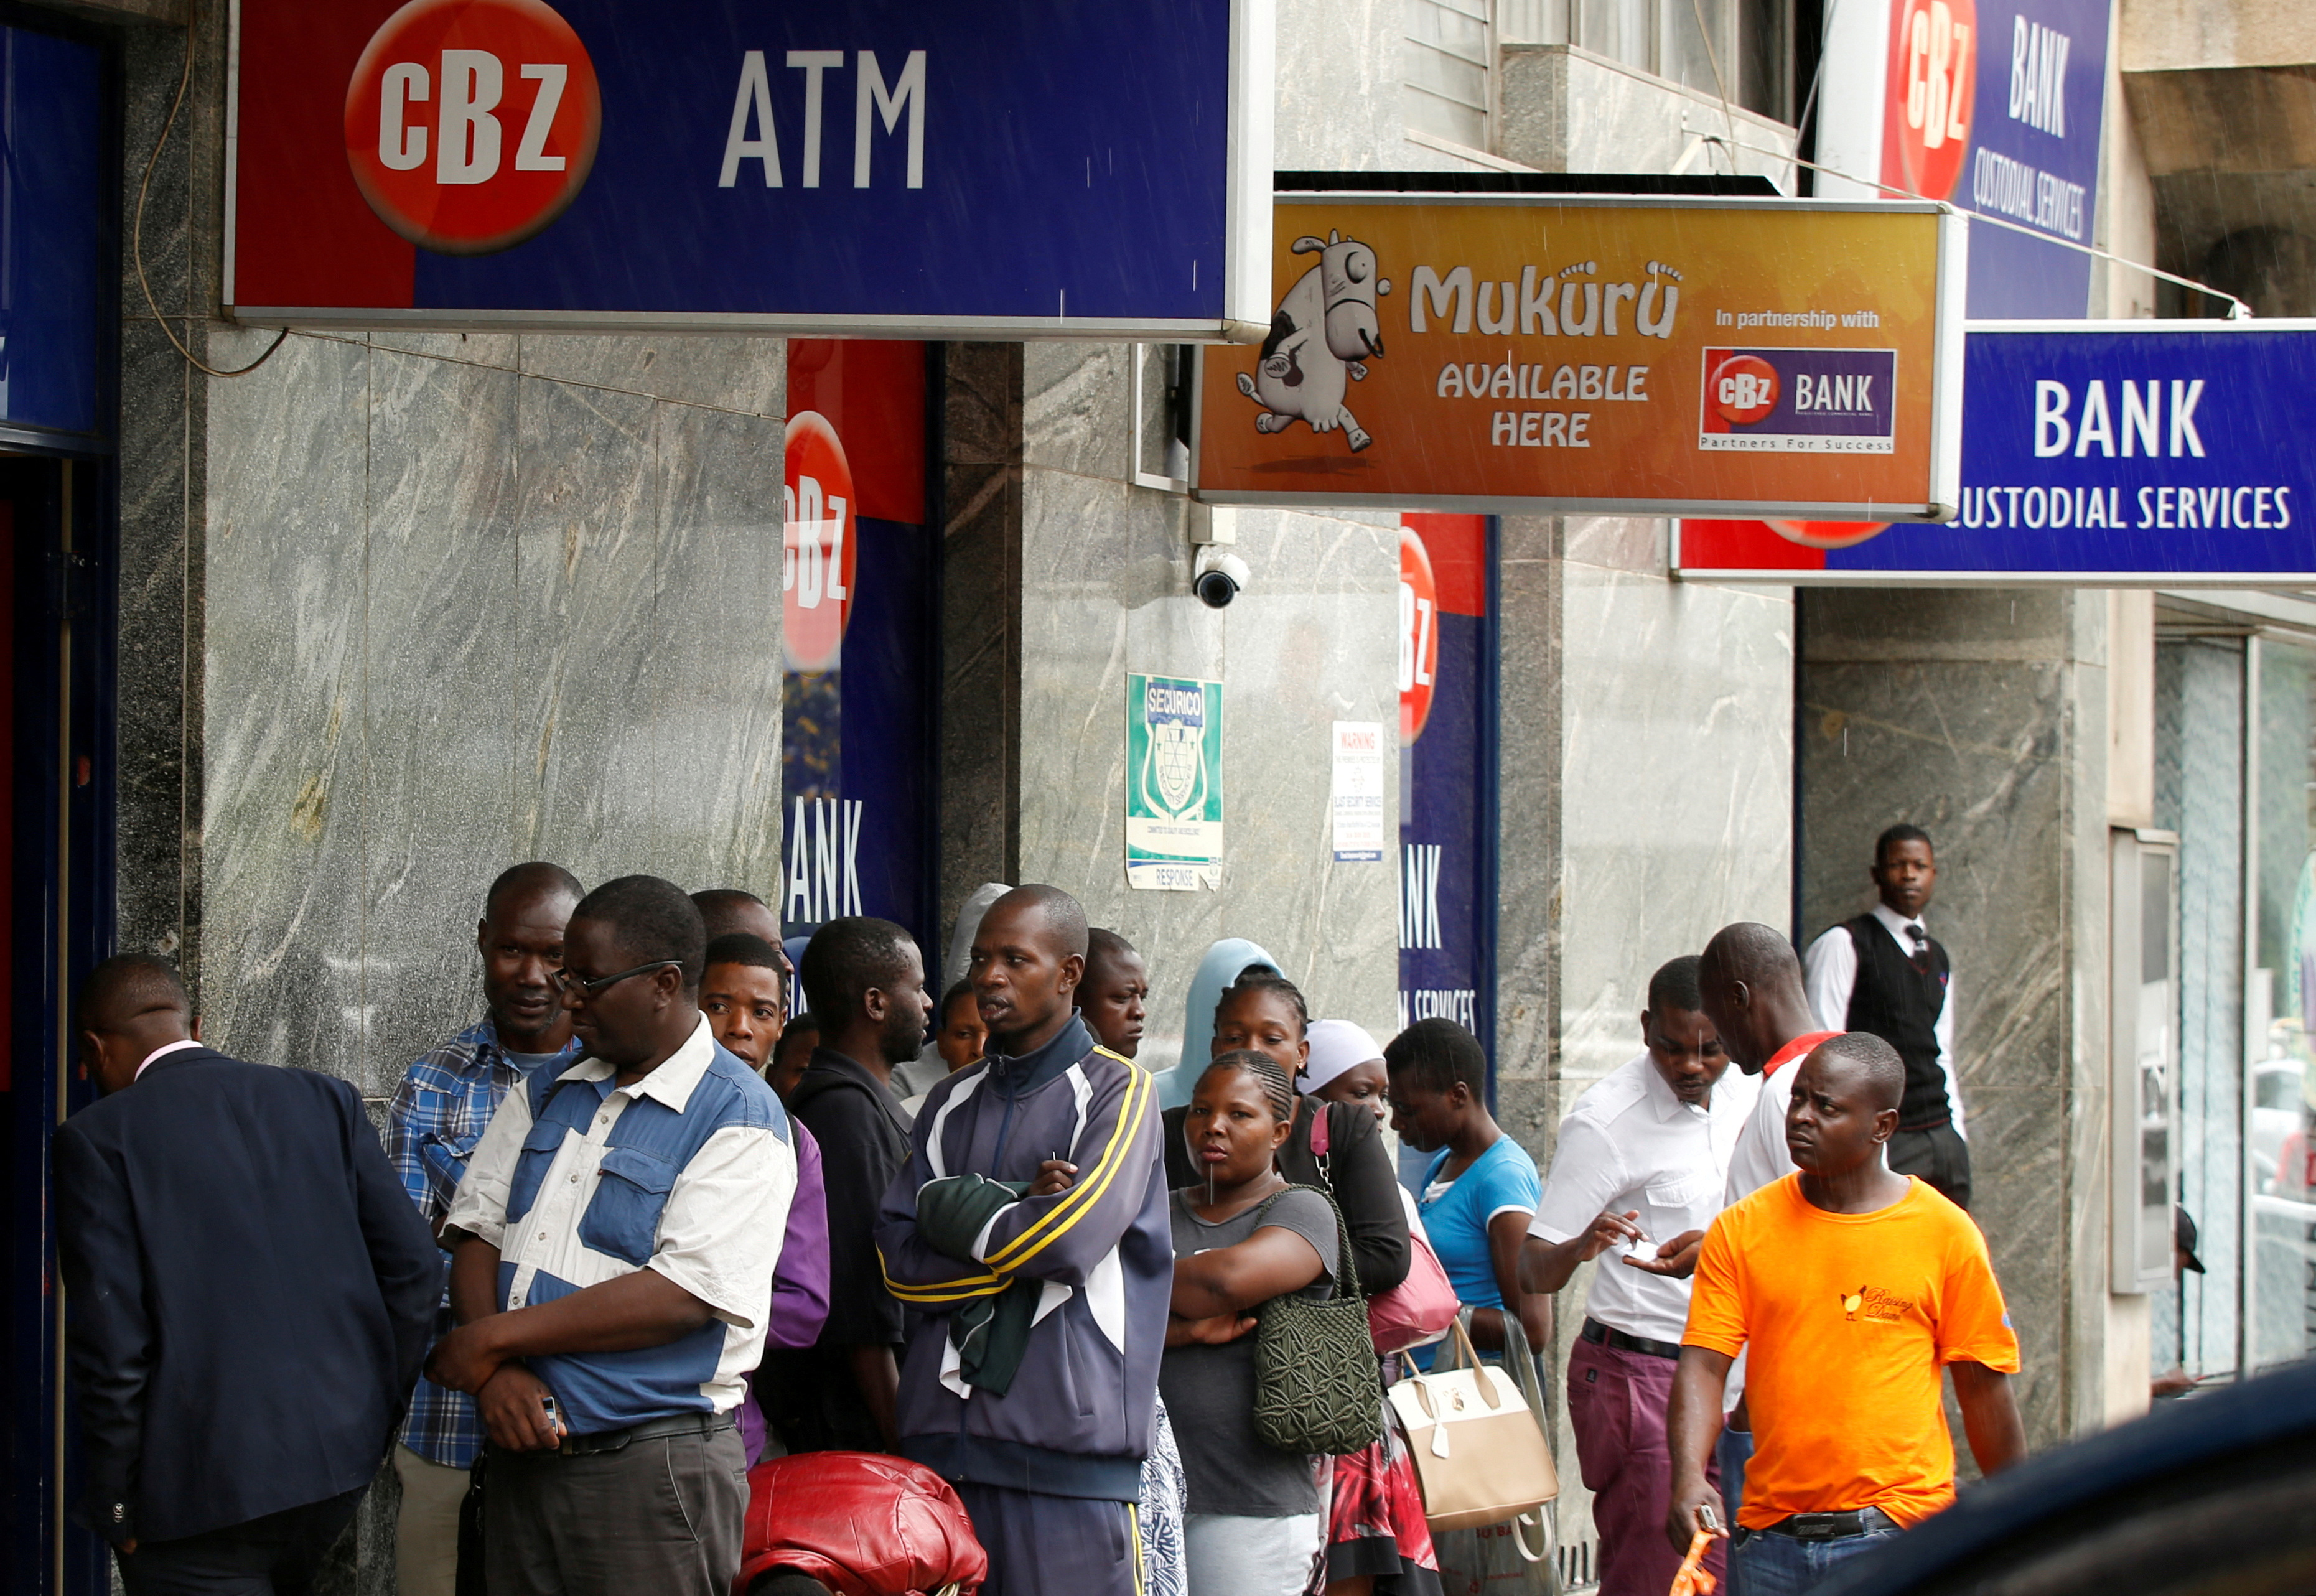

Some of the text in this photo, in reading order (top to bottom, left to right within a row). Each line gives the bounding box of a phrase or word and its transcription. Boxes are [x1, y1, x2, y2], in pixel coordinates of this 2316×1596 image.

[1907, 0, 1969, 149] CBZ
[2009, 14, 2070, 139] BANK
[378, 49, 568, 185] CBZ
[718, 50, 927, 189] ATM
[1974, 146, 2086, 240] CUSTODIAL SERVICES
[1716, 309, 1880, 330] In partnership with
[1437, 363, 1649, 401] AVAILABLE
[1718, 373, 1772, 409] CBZ
[1795, 374, 1873, 412] BANK
[1492, 411, 1591, 447] HERE
[2034, 379, 2206, 459] BANK
[1701, 437, 1892, 450] Partners For Success
[1945, 486, 2290, 530] USTODIAL SERVICES
[1398, 581, 1431, 692] BZ
[1148, 687, 1201, 717] SECURICO
[1340, 732, 1375, 749] WARNING
[780, 795, 862, 923] ANK
[1156, 869, 1193, 887] RESPONSE
[1398, 844, 1442, 949] NK
